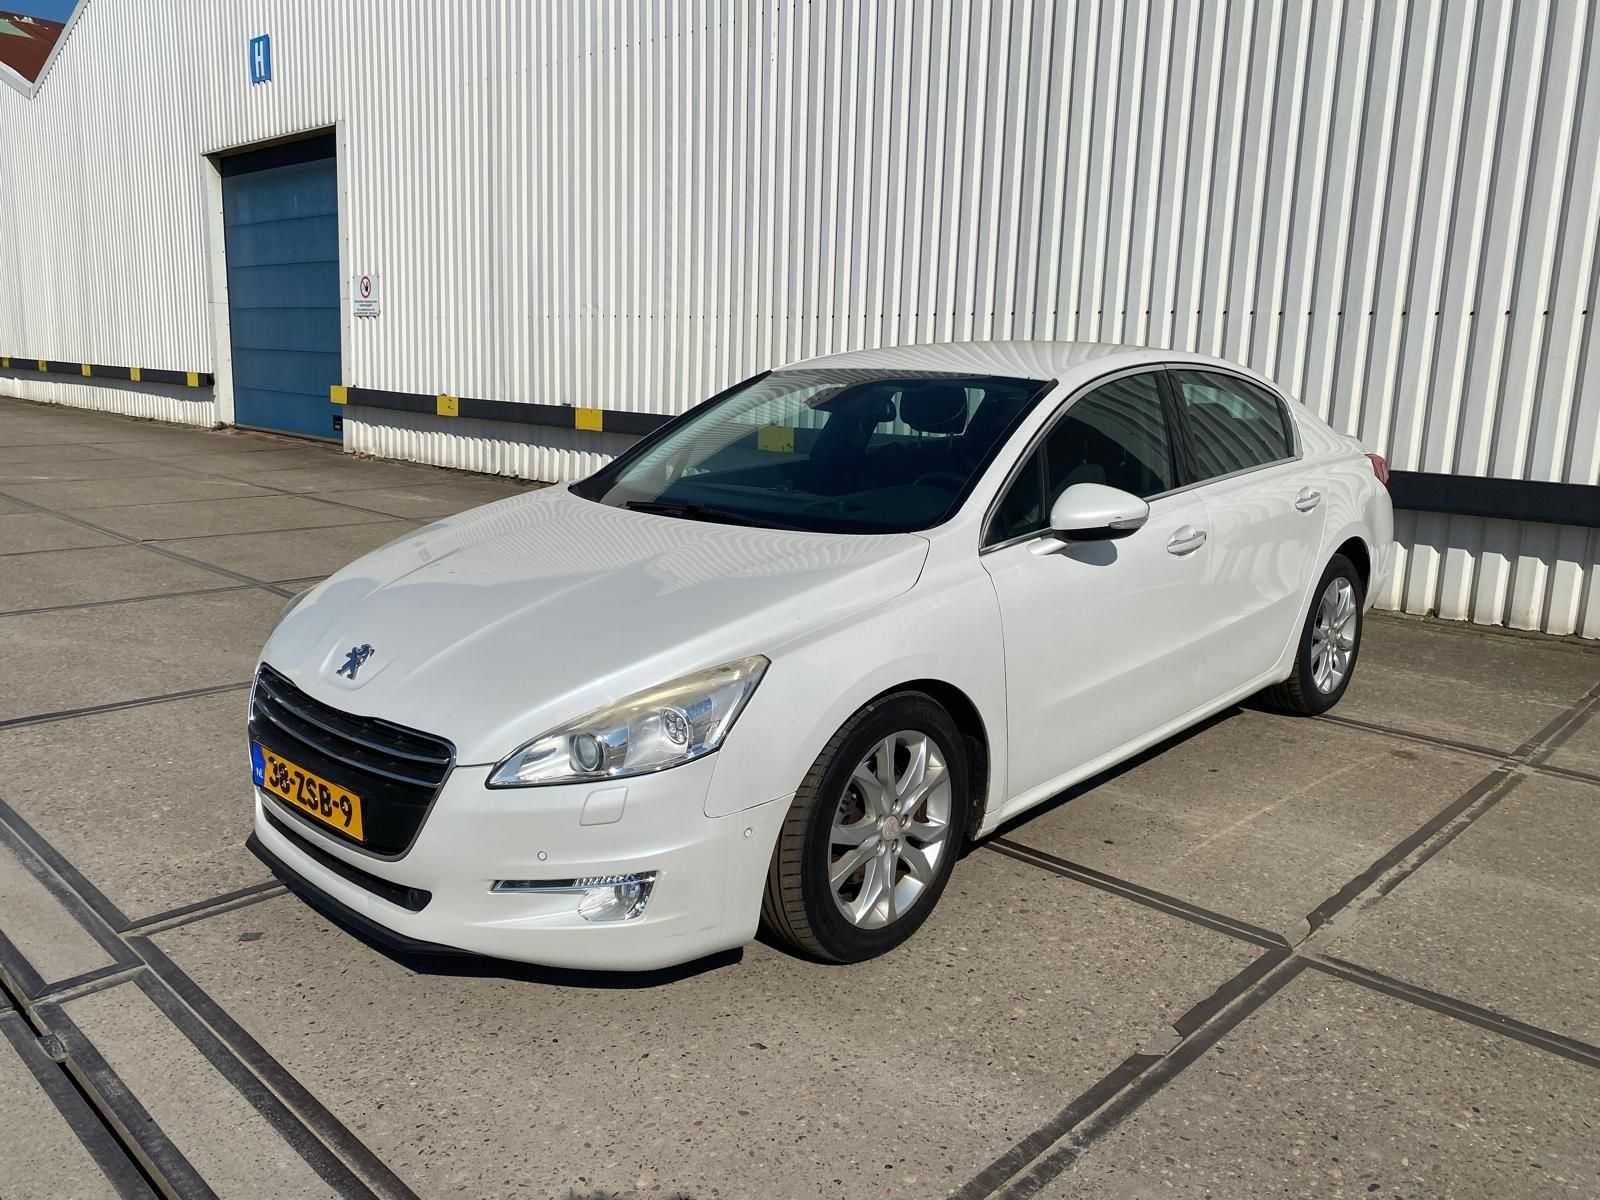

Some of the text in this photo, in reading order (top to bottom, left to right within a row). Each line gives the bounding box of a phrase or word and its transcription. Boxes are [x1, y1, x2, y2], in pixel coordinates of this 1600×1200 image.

[254, 40, 265, 78] H
[255, 767, 264, 779] NL
[267, 756, 353, 828] 38-ZSB-9
